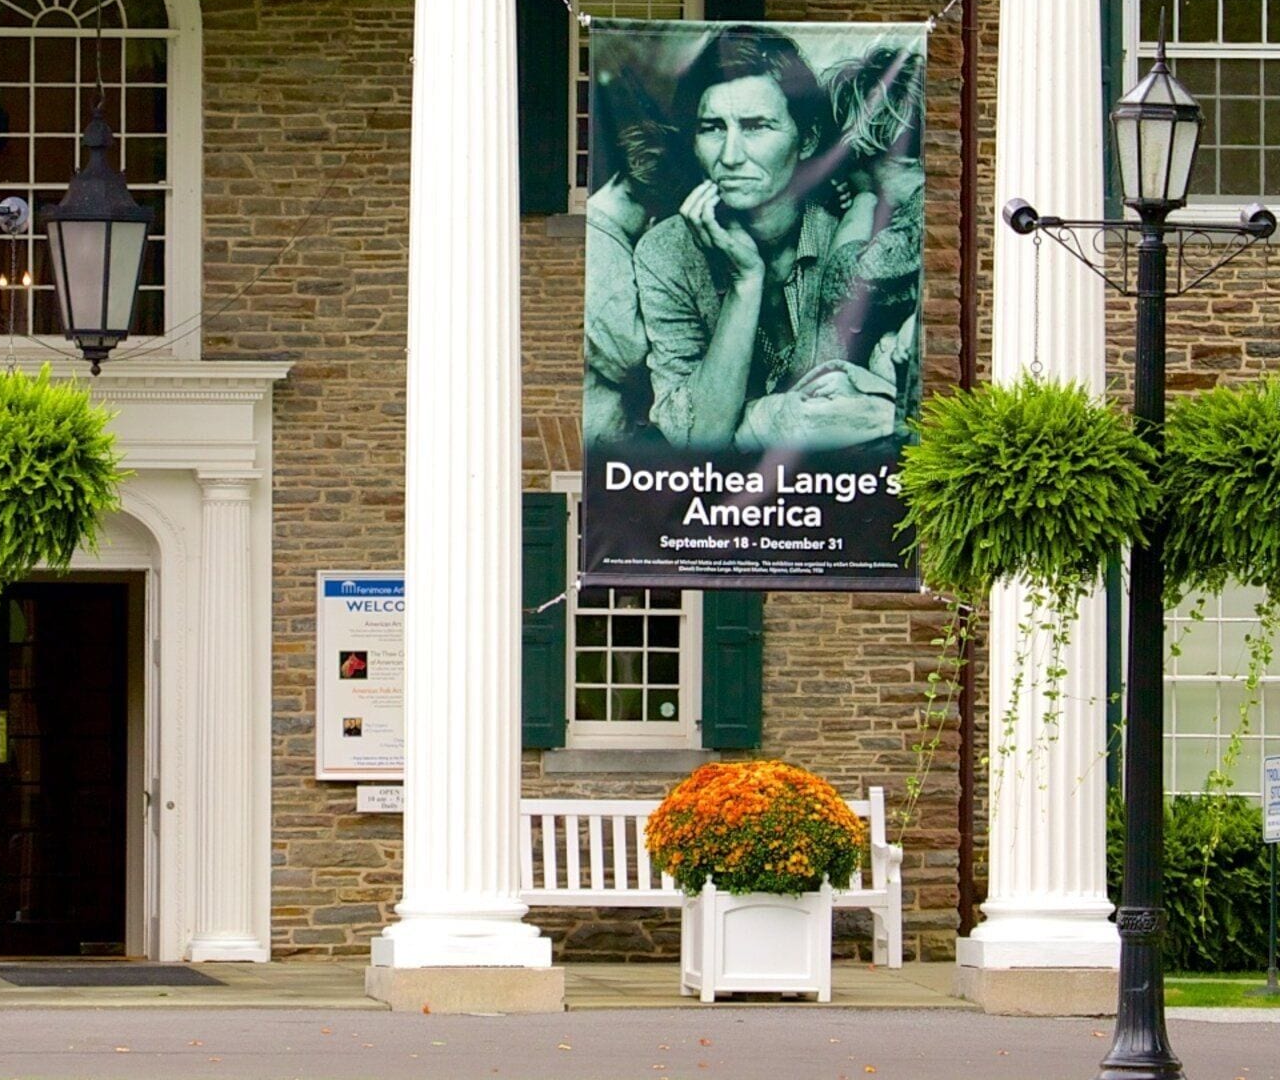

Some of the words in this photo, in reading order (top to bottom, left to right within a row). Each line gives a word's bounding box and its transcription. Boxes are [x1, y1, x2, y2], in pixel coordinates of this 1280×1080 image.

[606, 461, 763, 493] Dorothea
[777, 464, 902, 502] Lange's
[682, 497, 822, 527] America
[660, 535, 730, 550] September
[733, 537, 749, 549] 18
[760, 537, 825, 550] December
[828, 538, 843, 550] 31
[357, 586, 391, 594] Fenimore
[346, 600, 405, 612] WELCO
